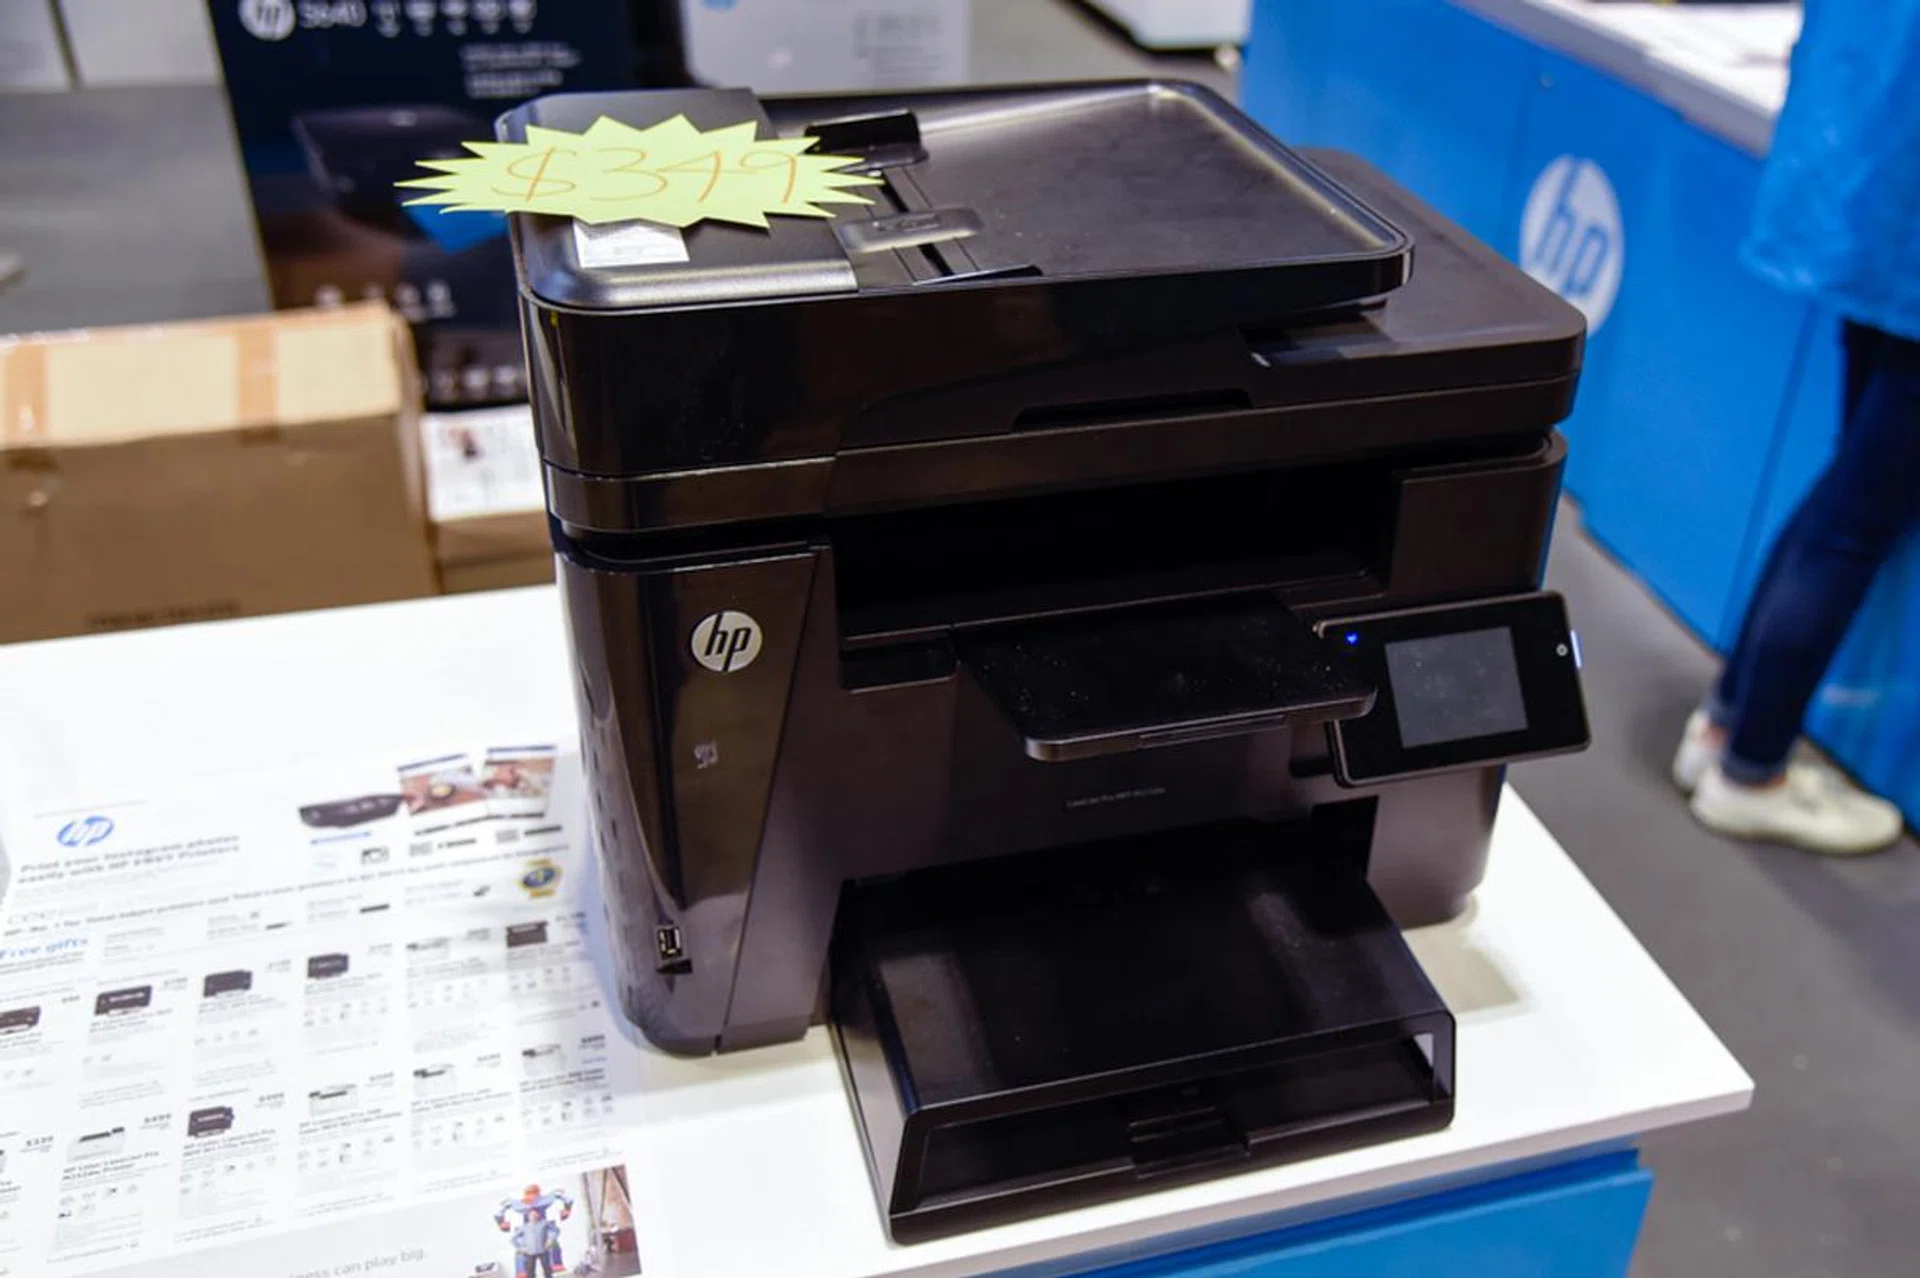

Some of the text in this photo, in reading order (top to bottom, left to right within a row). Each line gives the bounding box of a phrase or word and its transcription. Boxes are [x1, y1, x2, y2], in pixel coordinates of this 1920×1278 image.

[1530, 157, 1613, 299] hp
[699, 612, 757, 671] hp
[333, 1262, 361, 1276] can
[364, 1255, 397, 1271] play
